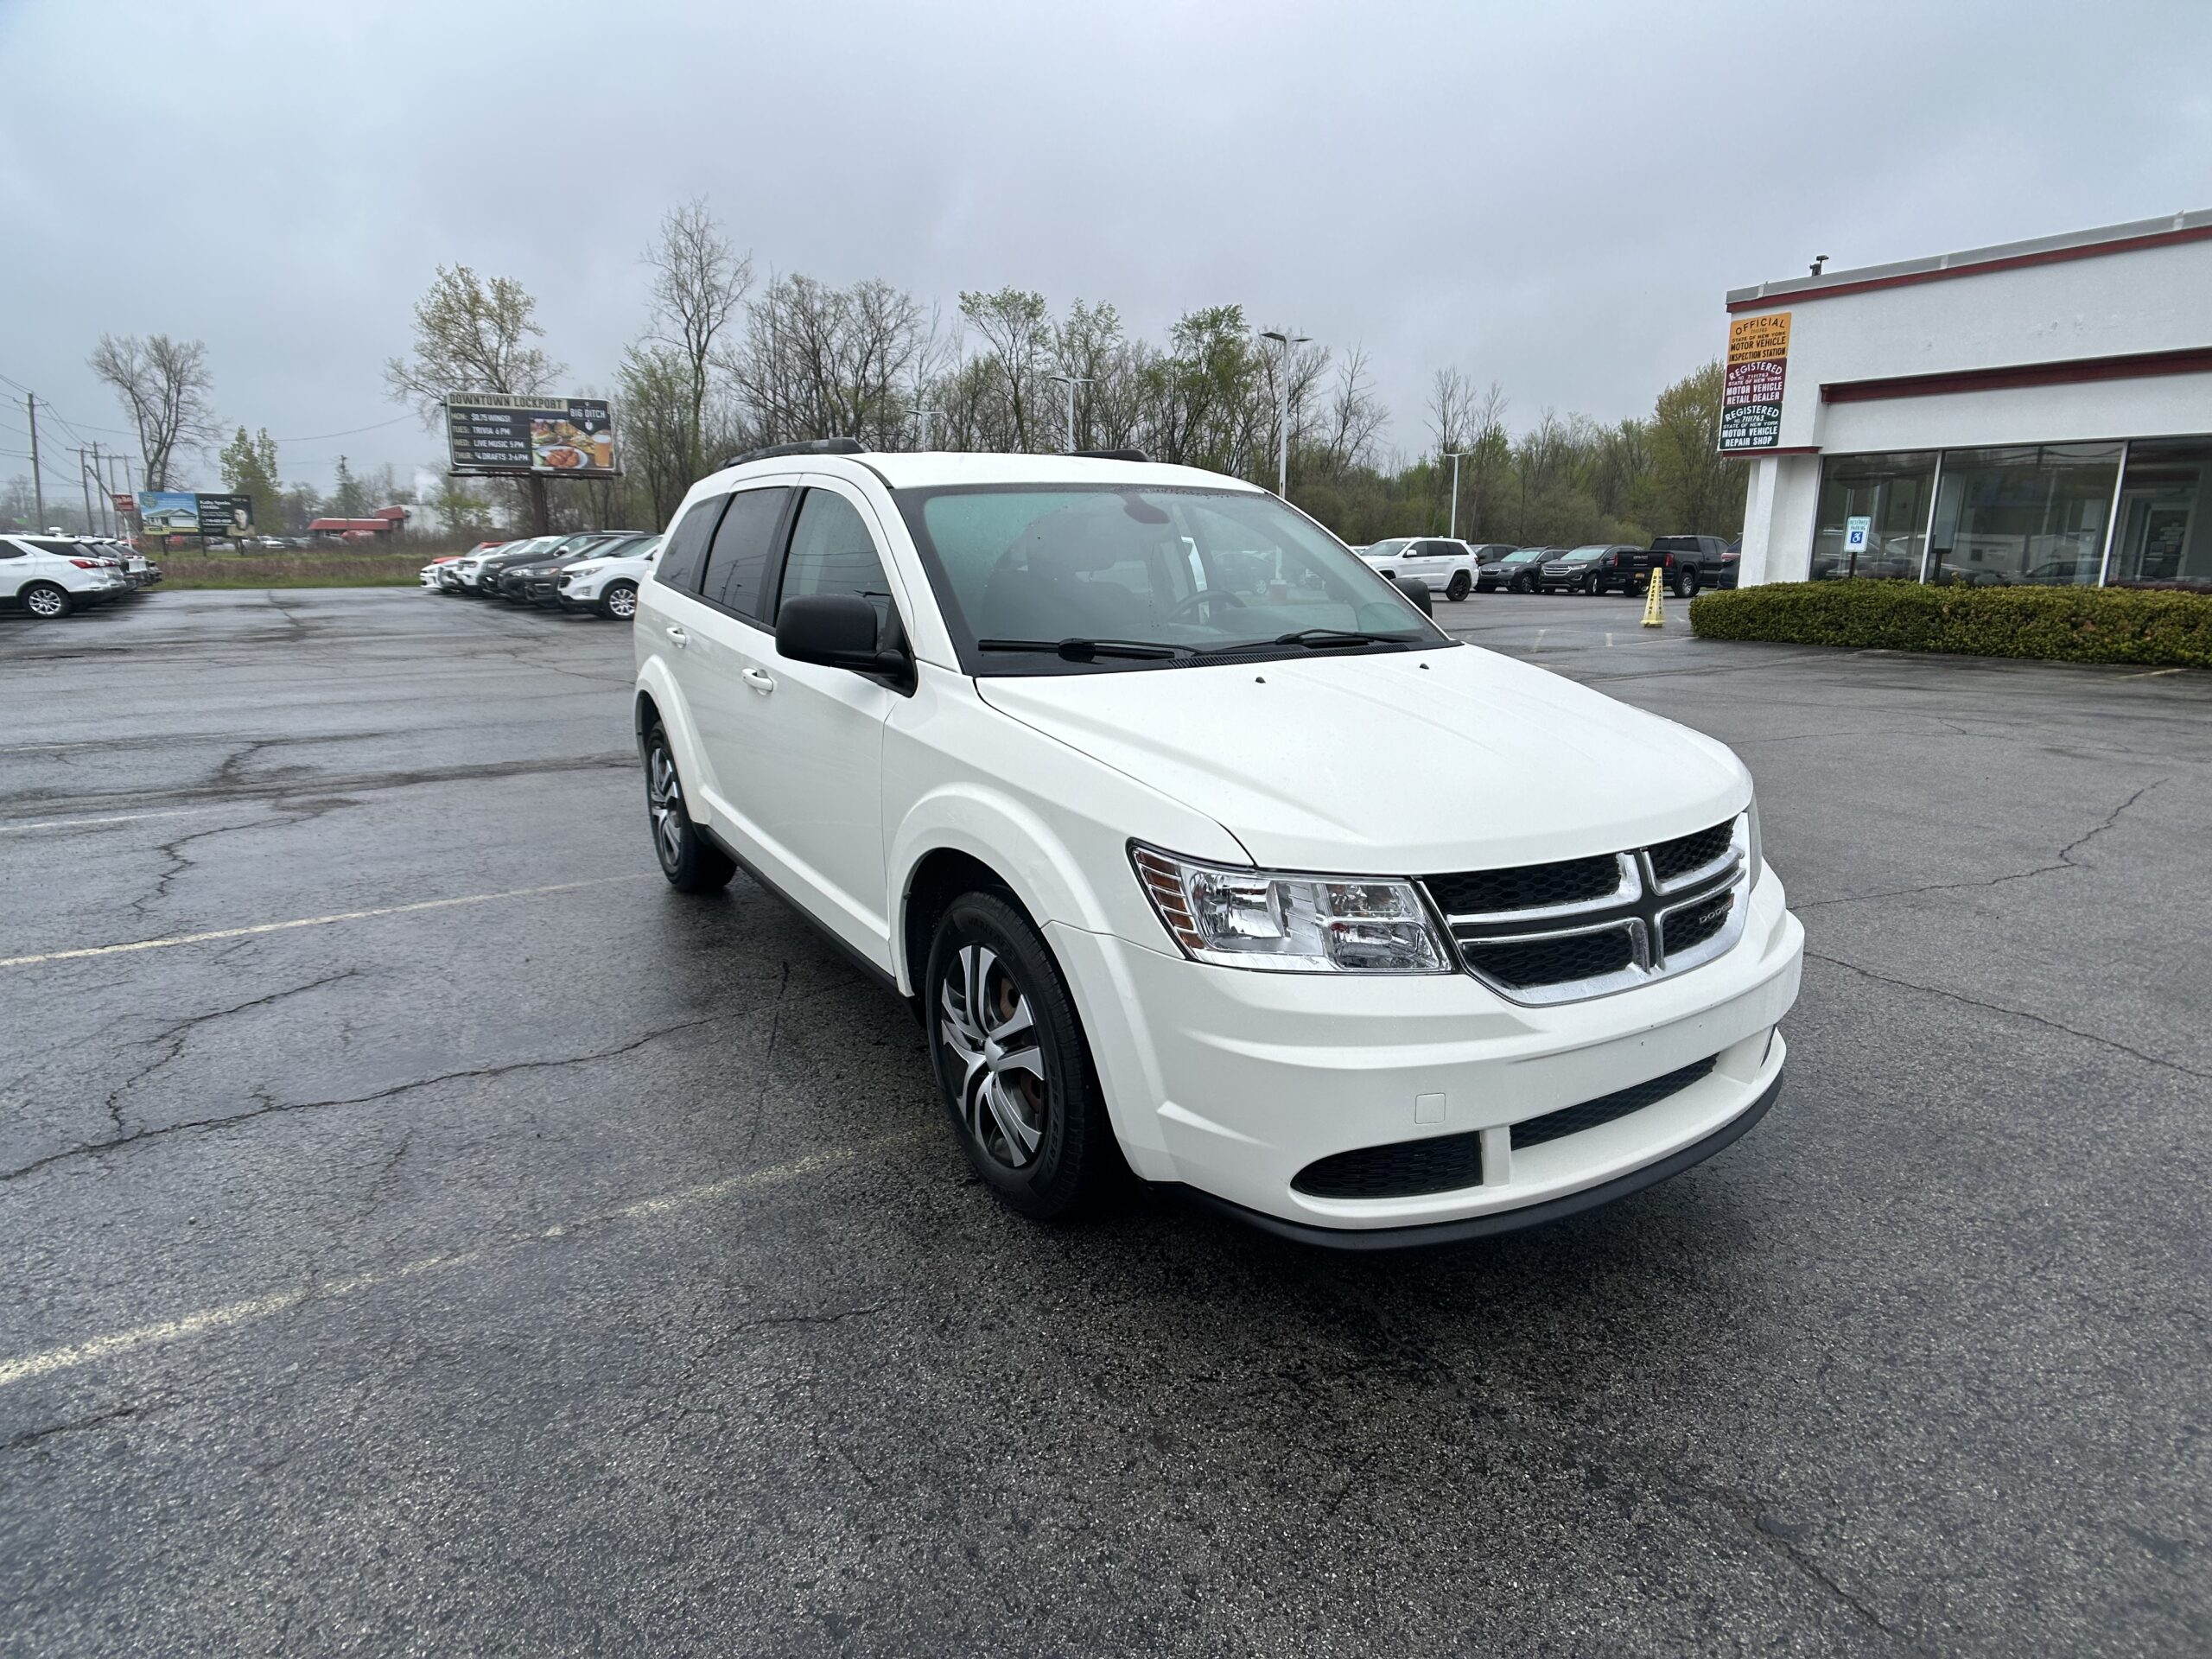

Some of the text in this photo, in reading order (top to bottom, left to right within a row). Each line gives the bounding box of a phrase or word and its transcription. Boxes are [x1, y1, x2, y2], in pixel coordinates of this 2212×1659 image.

[1735, 318, 1785, 335] OFFICIAL
[1731, 336, 1786, 352] MOTOR VEHICLE
[1730, 347, 1786, 361] INSPECTION STATION
[1729, 361, 1783, 380] REGISTERED
[1726, 382, 1783, 396] MOTOR VEHICLE
[449, 394, 563, 409] DOWNTOWN LOCKPORT
[1727, 391, 1780, 404] RETAIL DEALER
[570, 408, 605, 418] BIG DITCH
[1725, 405, 1779, 422] REGISTERED
[1722, 426, 1778, 438] MOTOR VEHICLE
[1726, 436, 1772, 448] REPAIR SHOP
